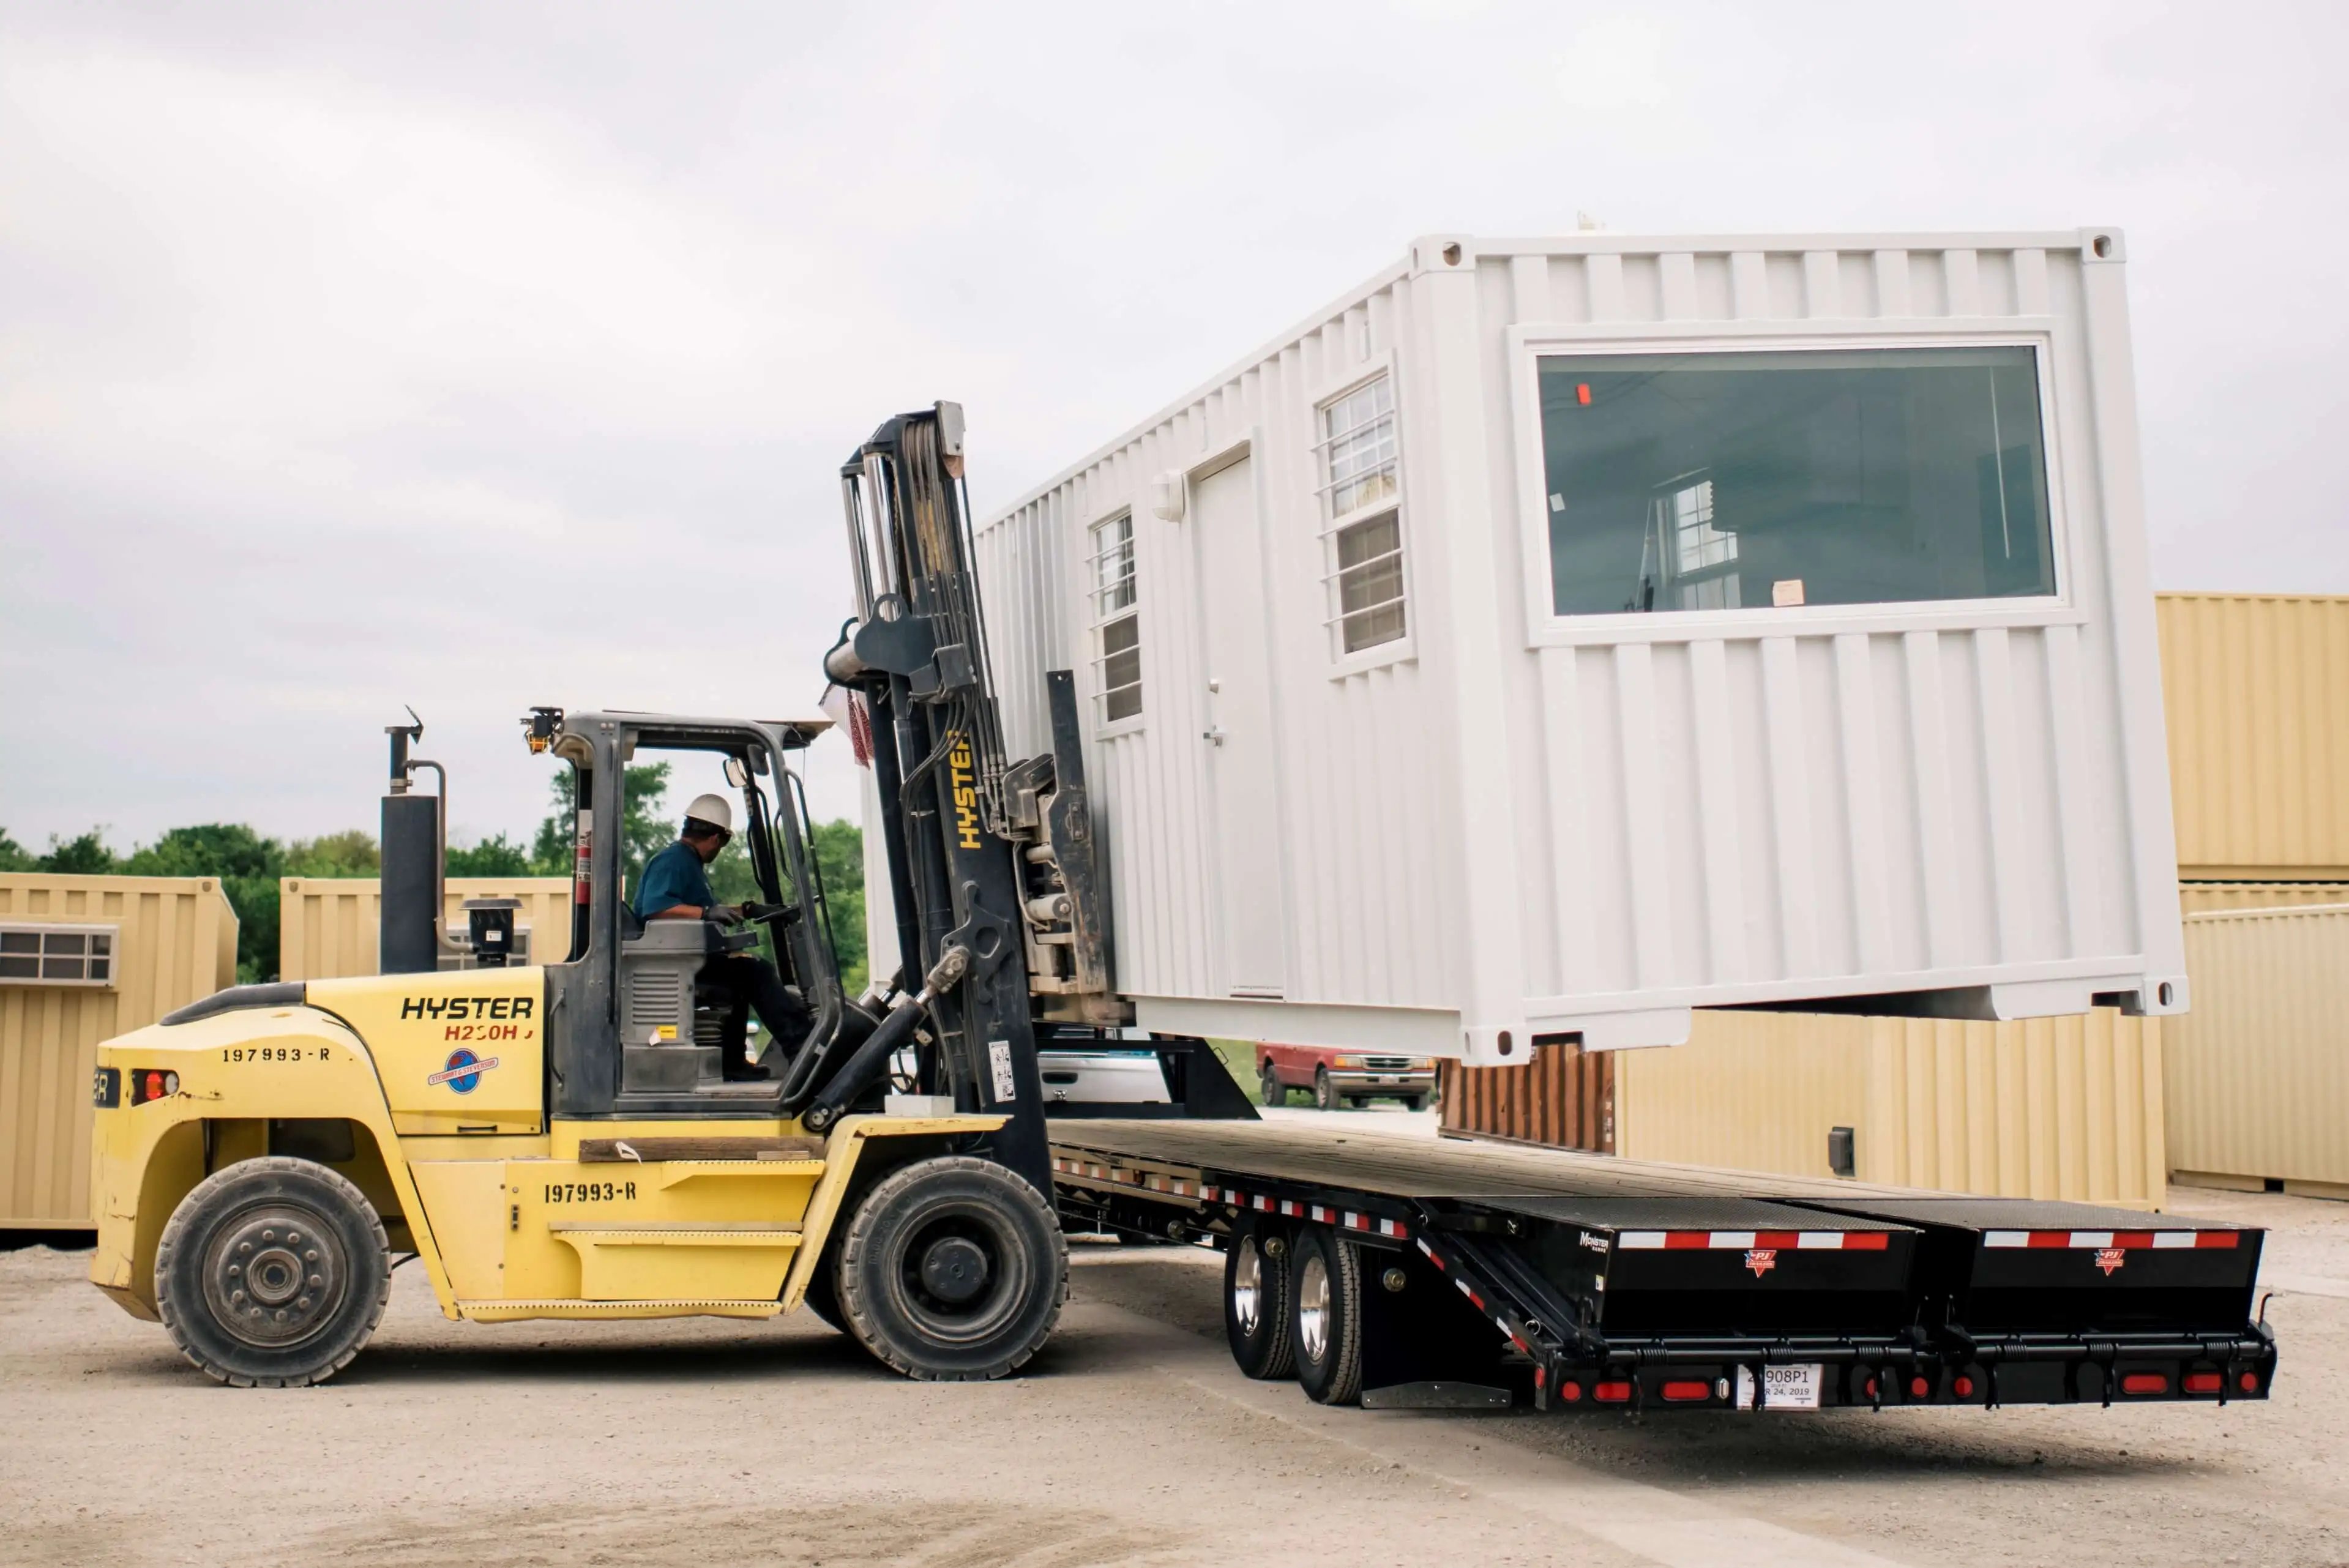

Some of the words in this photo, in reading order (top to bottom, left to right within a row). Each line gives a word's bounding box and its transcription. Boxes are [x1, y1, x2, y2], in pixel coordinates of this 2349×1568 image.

[401, 997, 534, 1020] HYSTER
[223, 1048, 330, 1062] 197993-R
[545, 1182, 636, 1203] 197993-R
[1747, 1370, 1809, 1383] 2908P1
